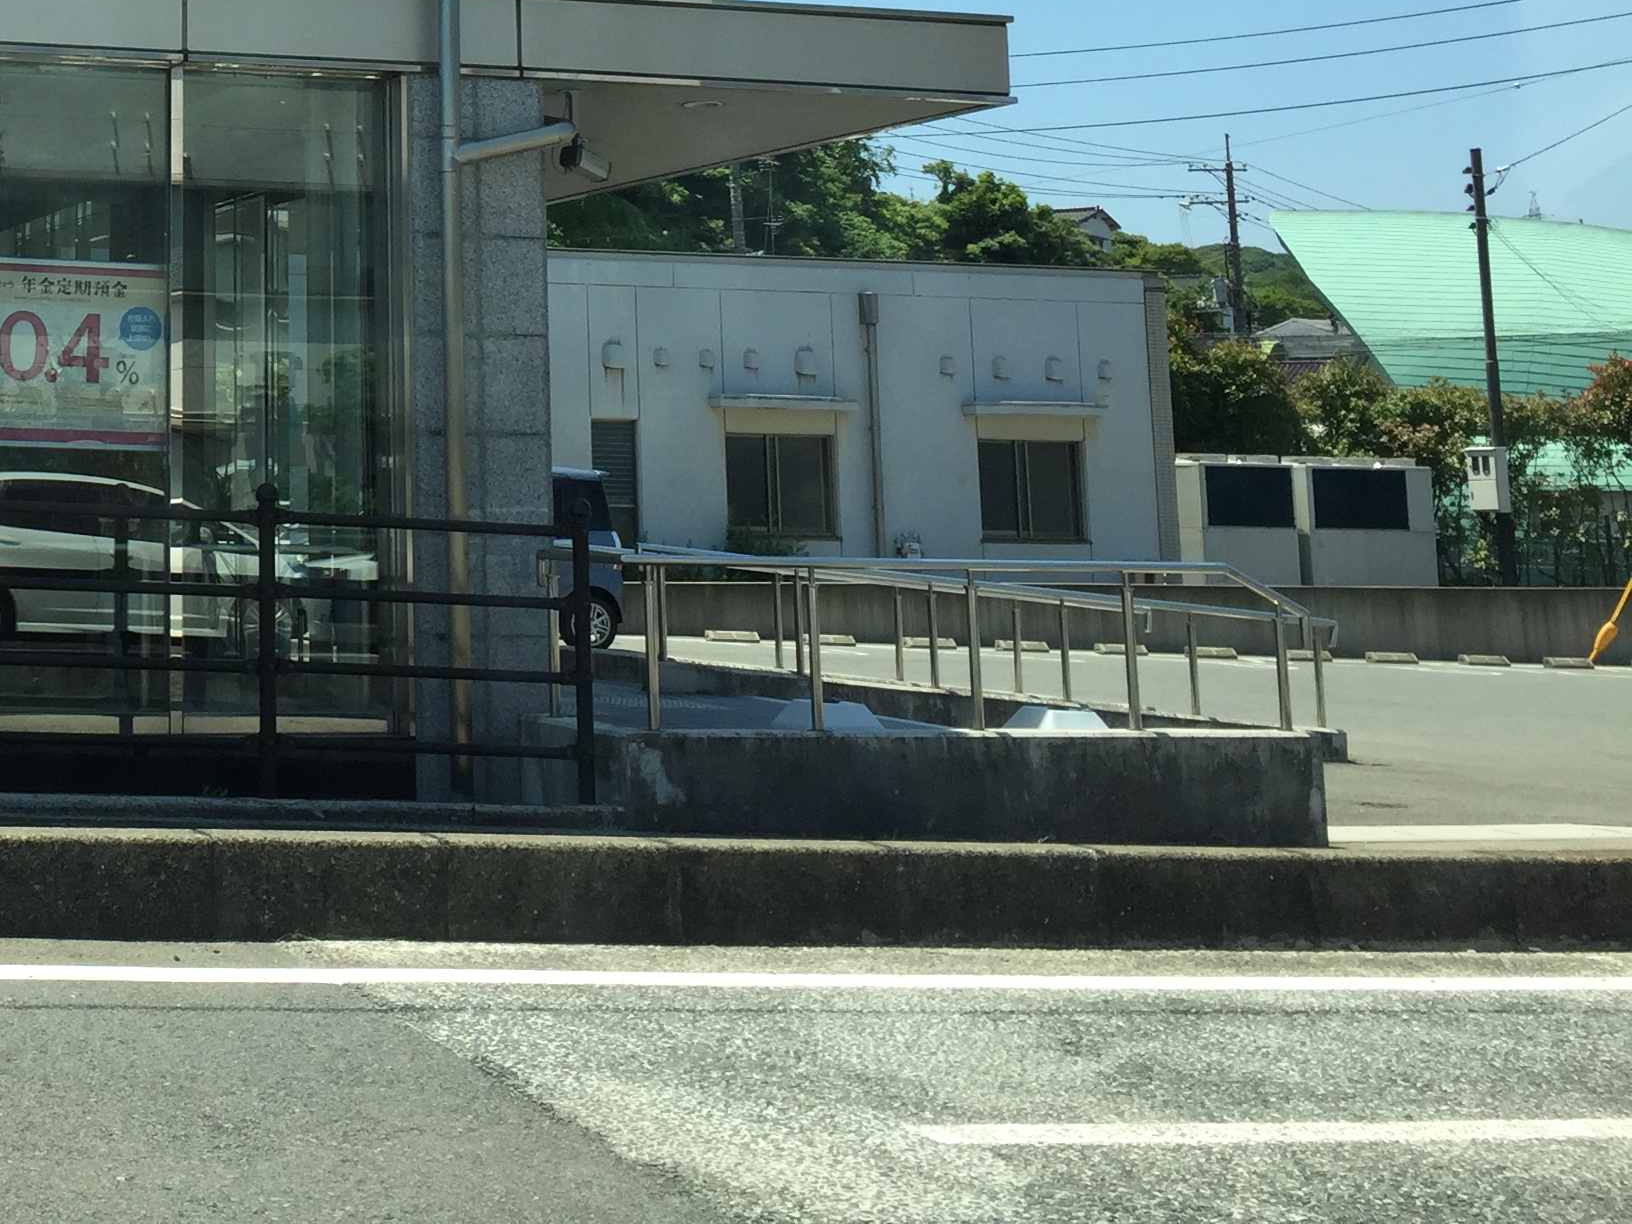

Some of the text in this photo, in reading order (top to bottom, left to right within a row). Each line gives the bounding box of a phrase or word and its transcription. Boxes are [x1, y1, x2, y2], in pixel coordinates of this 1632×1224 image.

[20, 275, 128, 299] 年金定期預金
[115, 360, 140, 385] %
